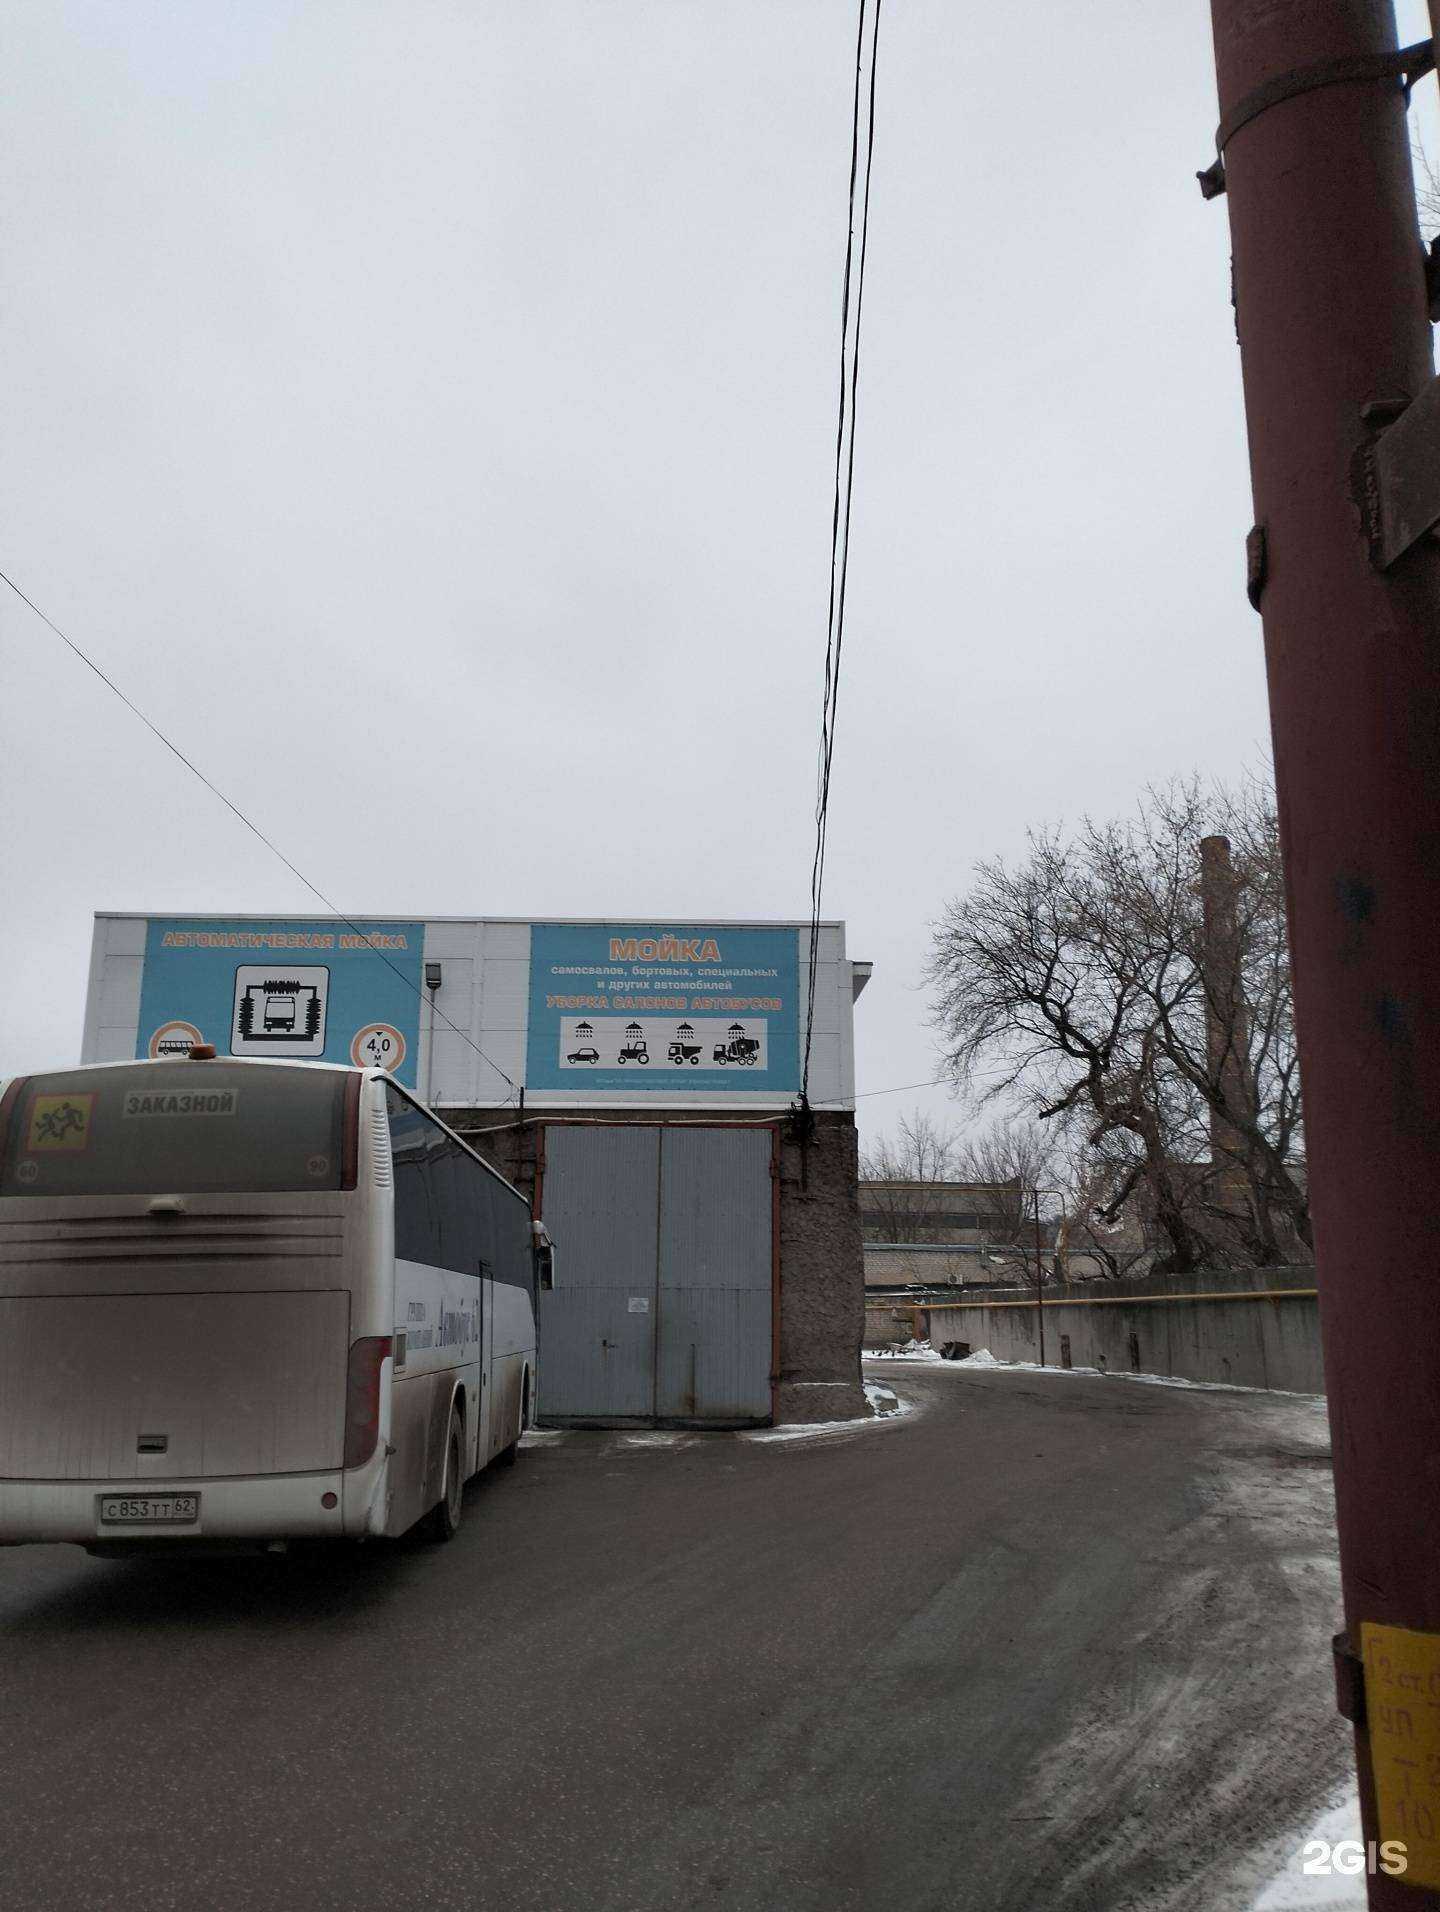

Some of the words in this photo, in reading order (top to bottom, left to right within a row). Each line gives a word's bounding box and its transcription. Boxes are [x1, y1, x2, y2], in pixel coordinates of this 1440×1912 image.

[161, 932, 334, 948] АВТОМАТИЧЕСКАЯ
[339, 931, 407, 949] МОЙКА
[609, 934, 722, 962] МОЙКА
[551, 966, 628, 977] самосвалов,
[632, 965, 693, 978] бортовых,
[697, 967, 778, 978] специальных
[597, 981, 605, 989] и
[608, 980, 650, 991] других
[653, 979, 733, 991] автомобилей
[546, 995, 608, 1009] УБОРКА
[612, 996, 687, 1010] САЛОНОВ
[691, 997, 782, 1011] АВТОБУСОВ
[127, 1092, 235, 1114] ЗАКАЗНОЙ
